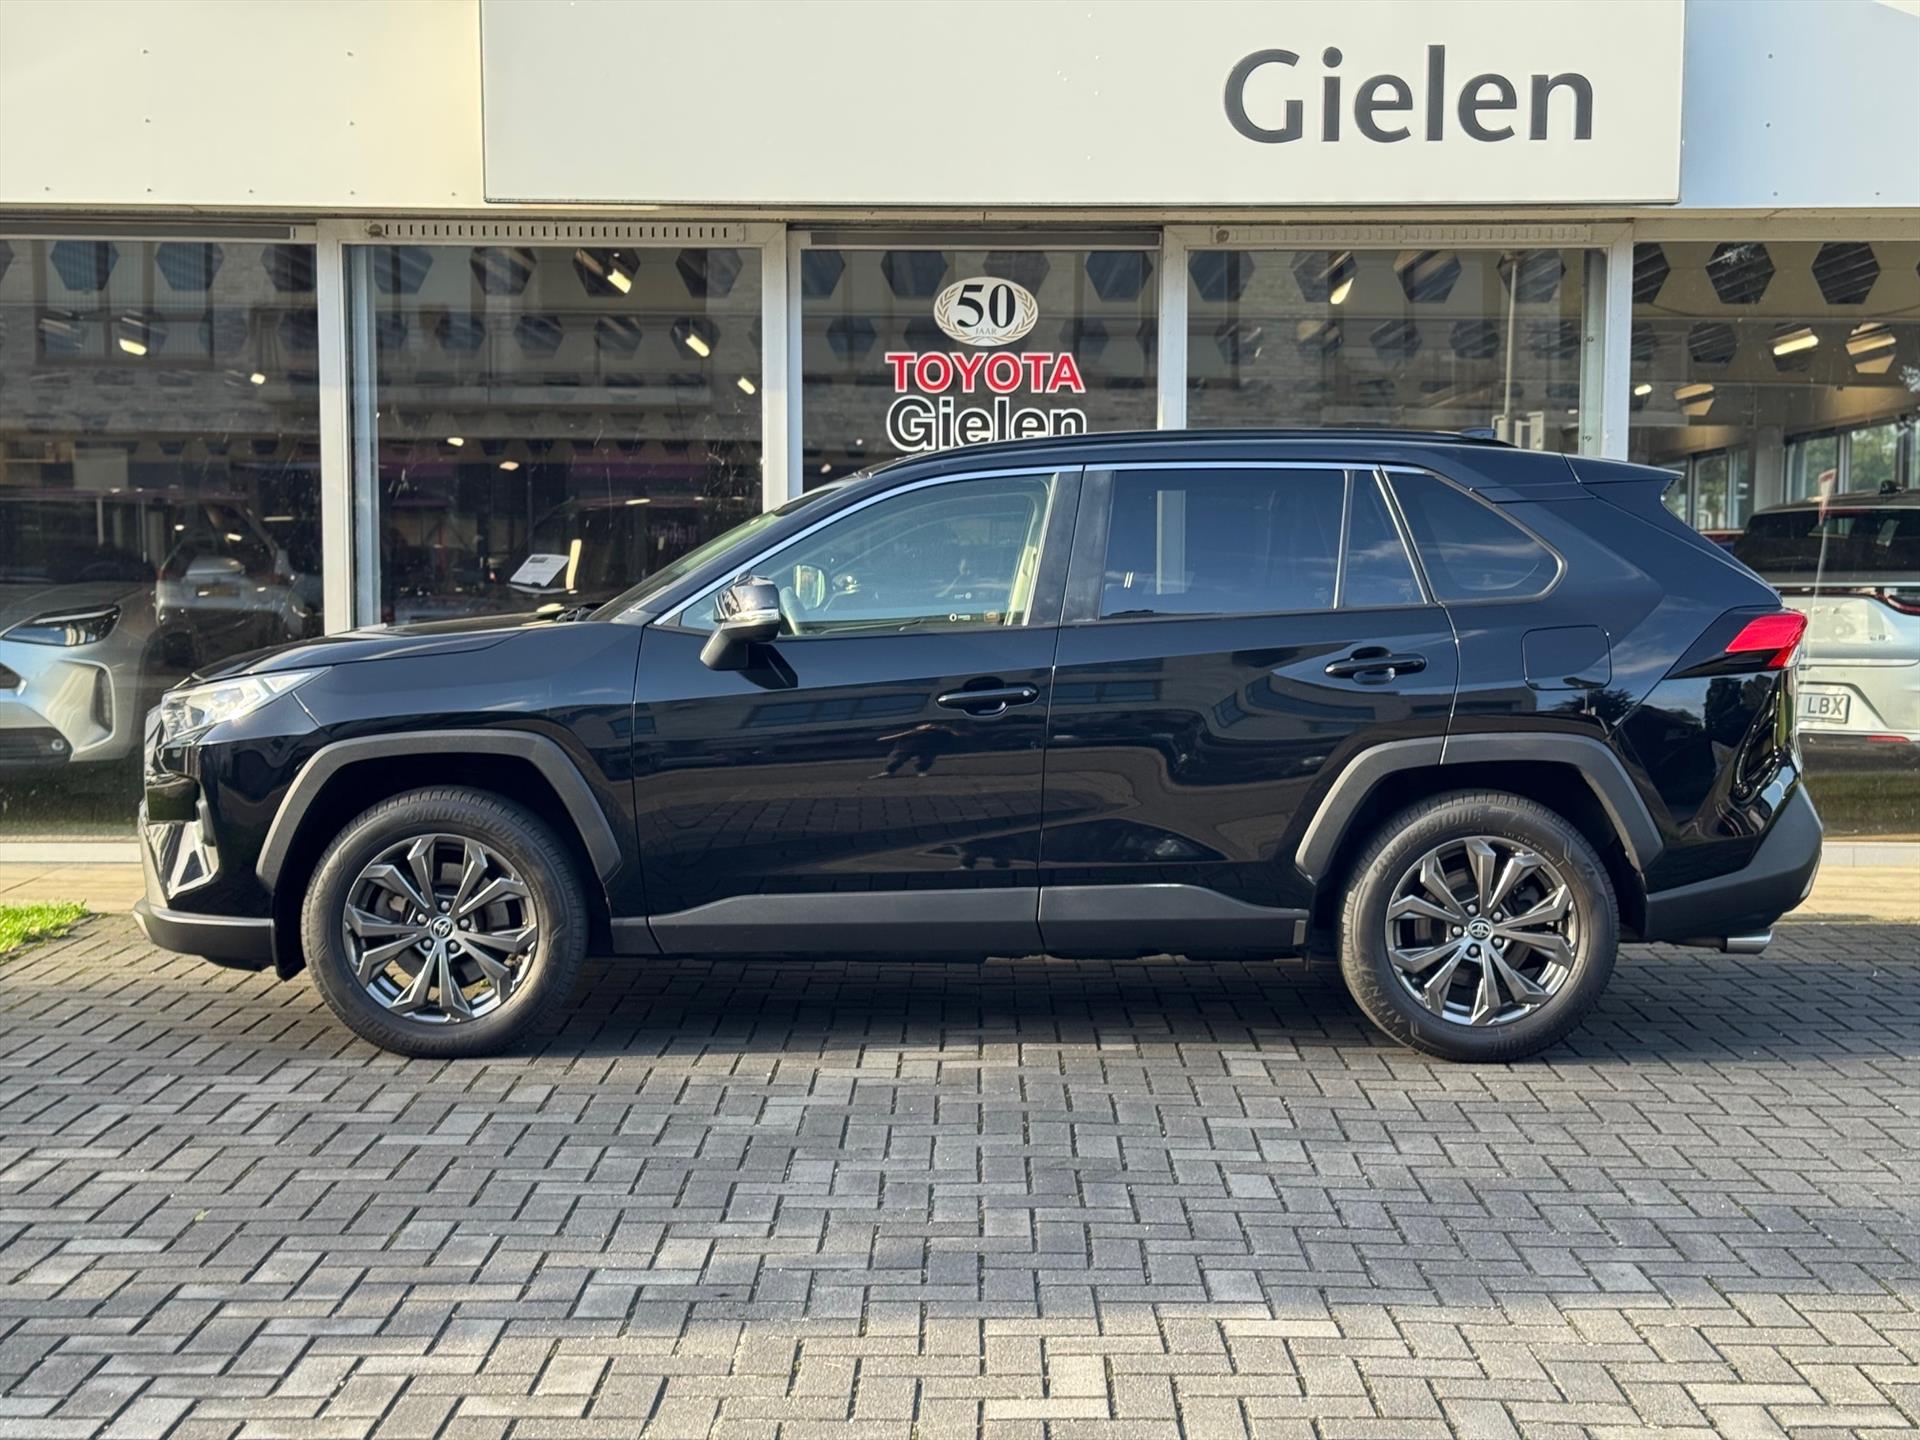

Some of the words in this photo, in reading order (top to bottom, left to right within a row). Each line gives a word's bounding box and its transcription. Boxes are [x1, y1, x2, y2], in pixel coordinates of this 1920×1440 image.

[1224, 45, 1593, 143] Gielen
[957, 284, 1016, 328] 50
[885, 352, 1086, 393] TOYOTA
[887, 395, 1087, 451] Gielen
[1807, 697, 1844, 715] LBX
